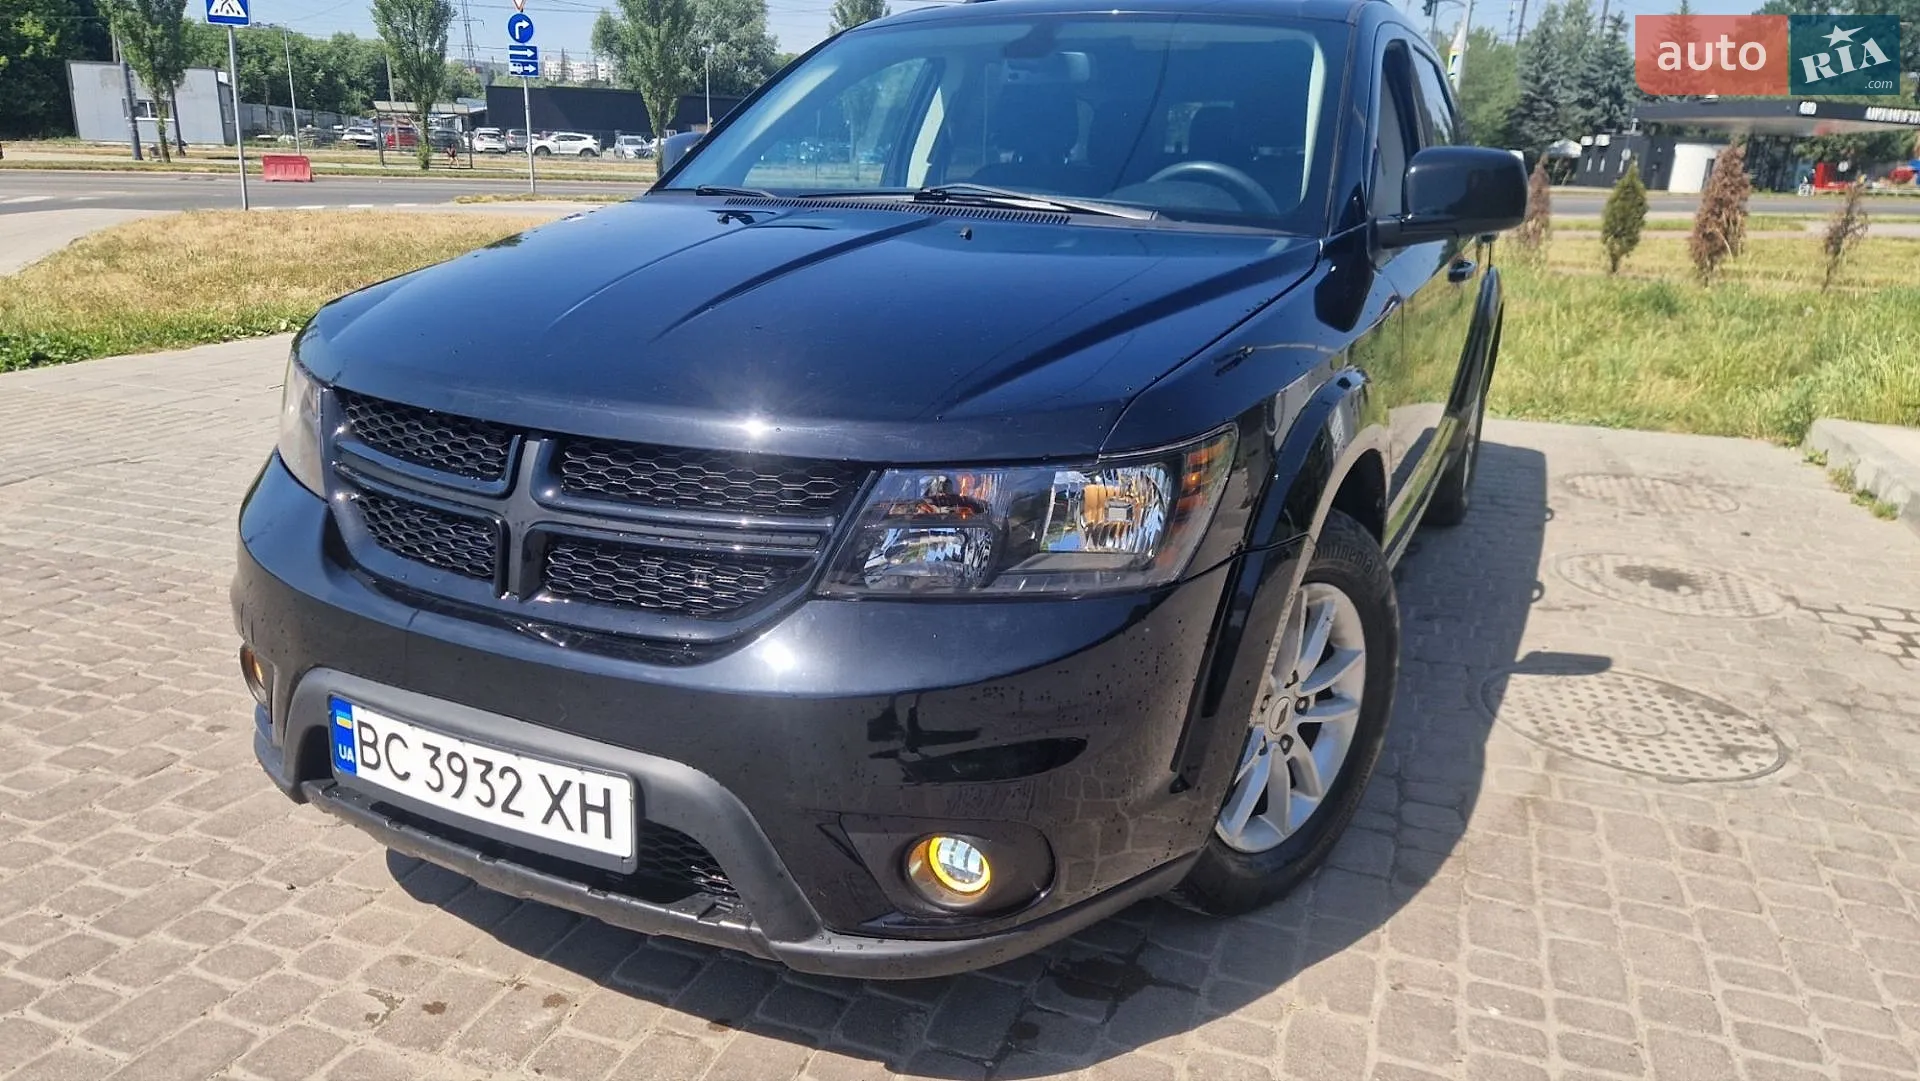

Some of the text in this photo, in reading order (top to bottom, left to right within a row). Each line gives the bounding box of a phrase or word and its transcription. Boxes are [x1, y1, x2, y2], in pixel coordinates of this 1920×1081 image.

[1314, 541, 1375, 576] ontinental
[338, 743, 355, 763] UA
[356, 719, 613, 840] BC 3932 XH
